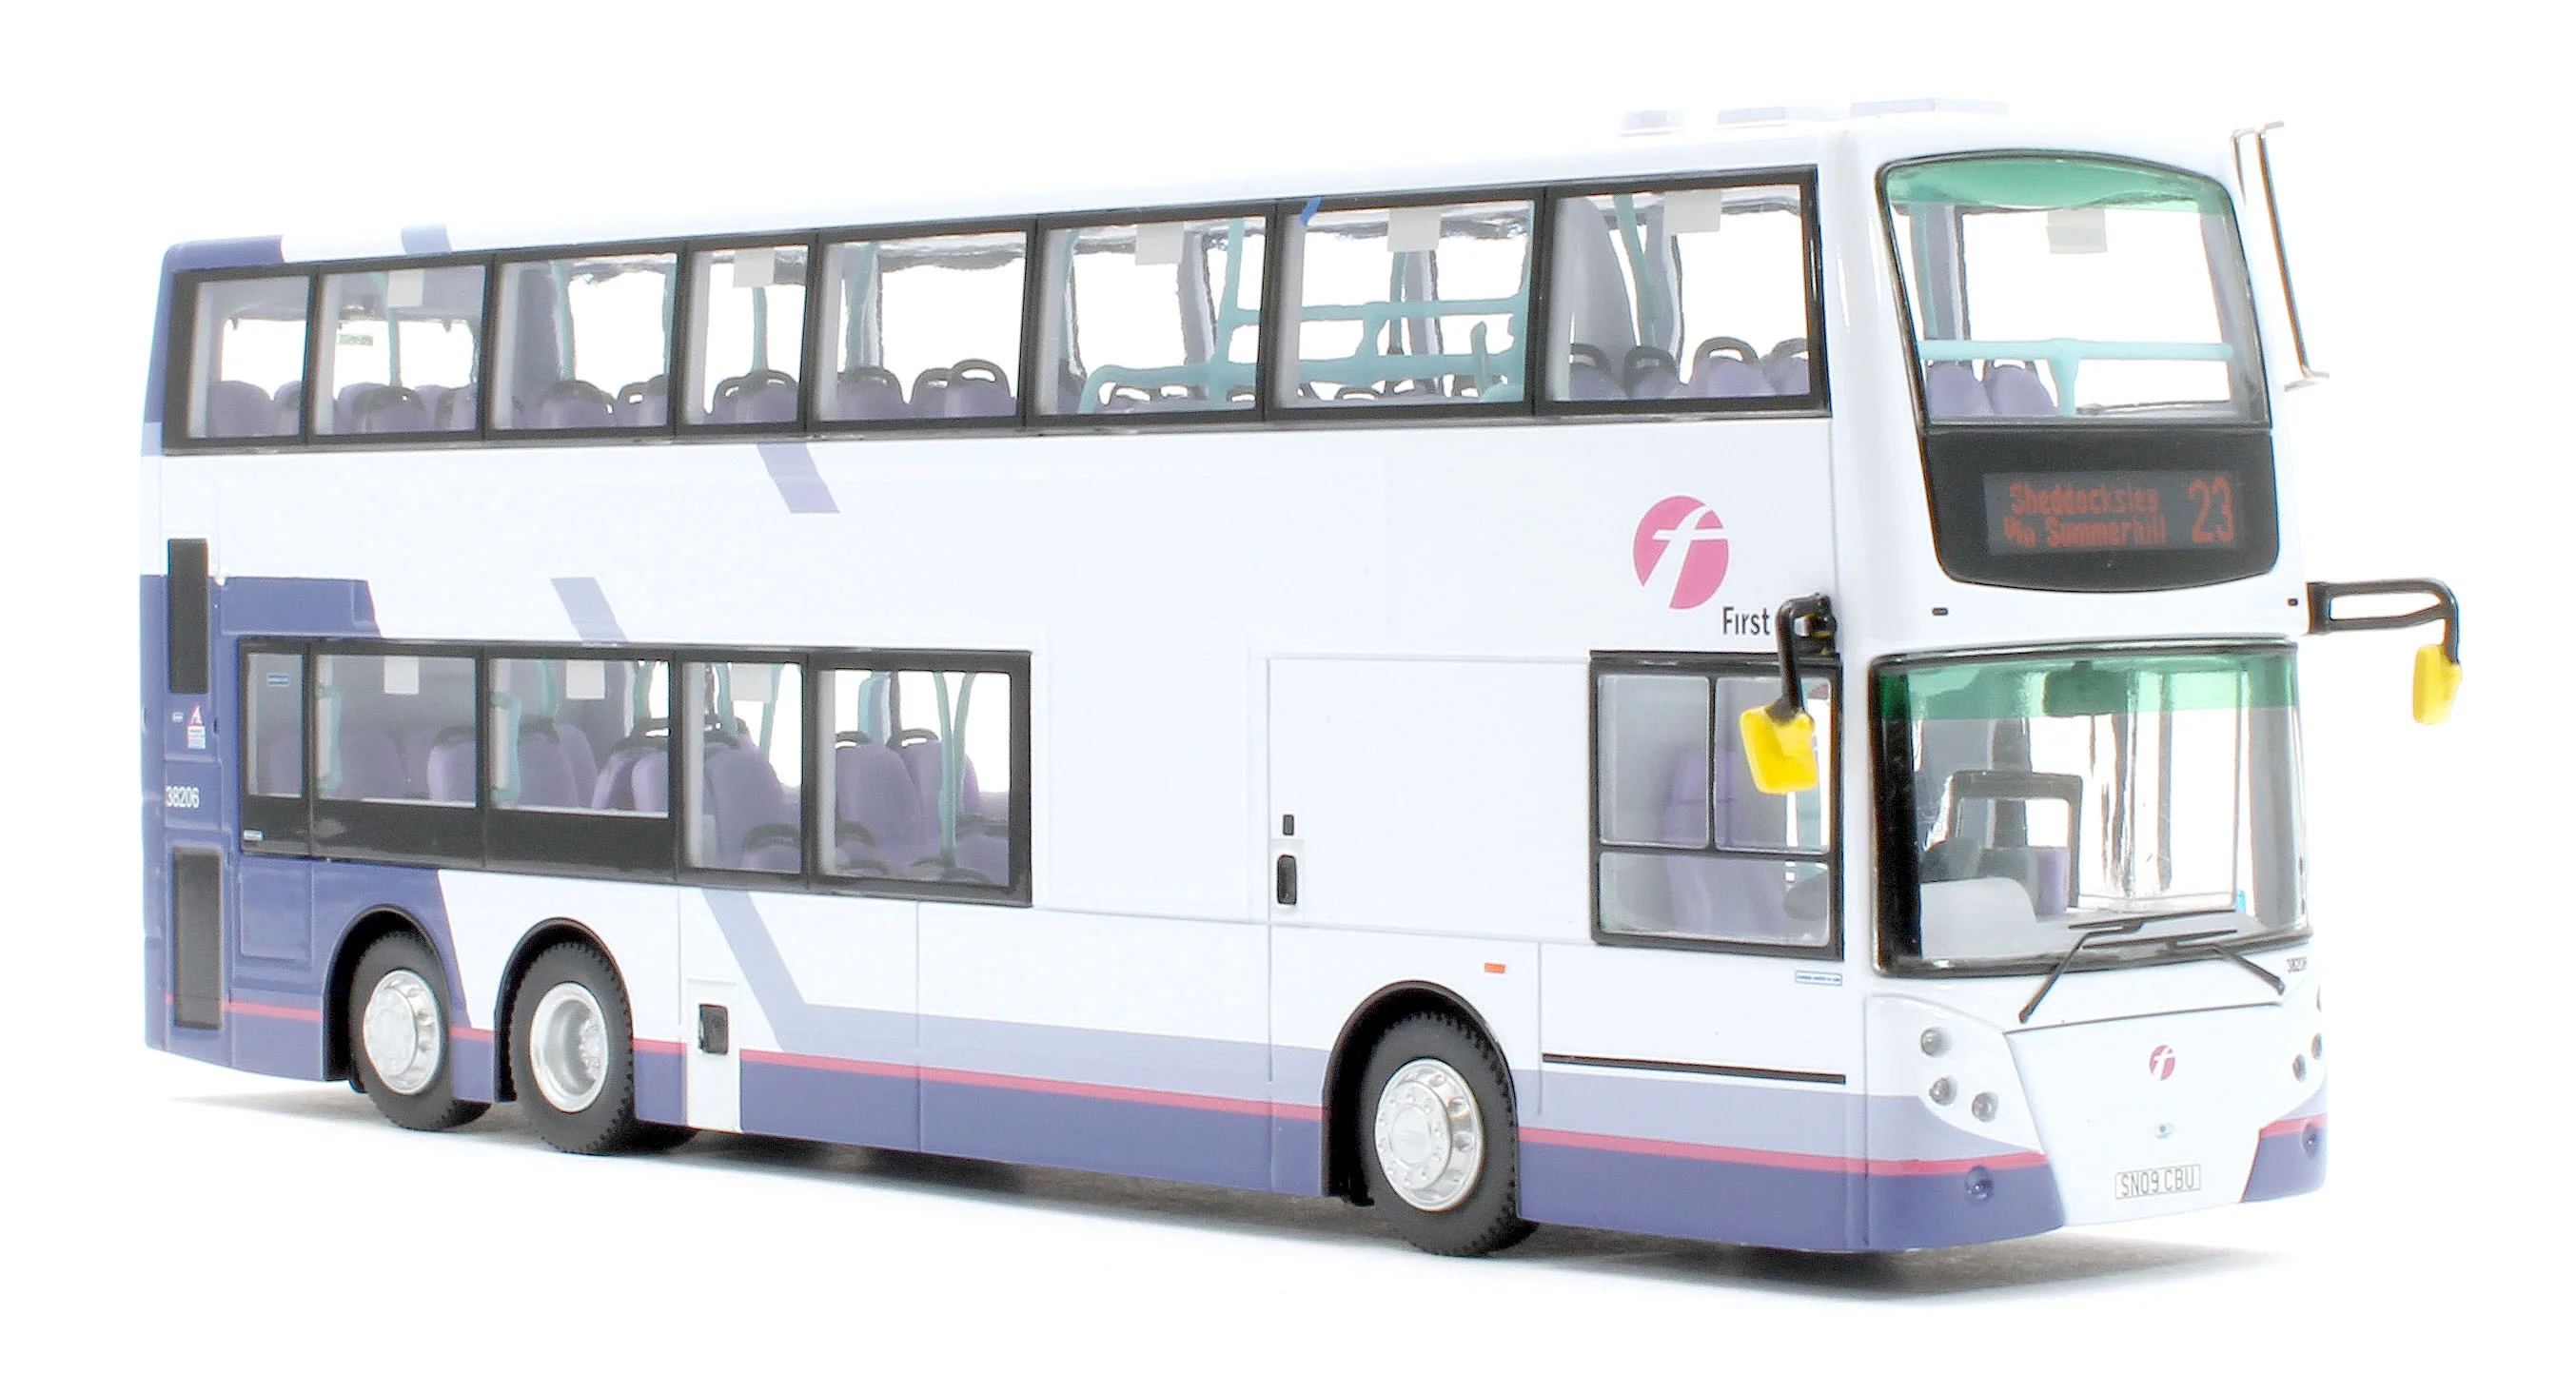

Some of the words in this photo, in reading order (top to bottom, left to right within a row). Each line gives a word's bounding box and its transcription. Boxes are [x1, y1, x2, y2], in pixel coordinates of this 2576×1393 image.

[2188, 477, 2235, 544] 23
[2046, 515, 2168, 548] Summerhill
[1722, 607, 1770, 636] First
[165, 785, 201, 809] 38206
[2120, 1169, 2159, 1197] SN09
[2164, 1166, 2194, 1191] CBU
